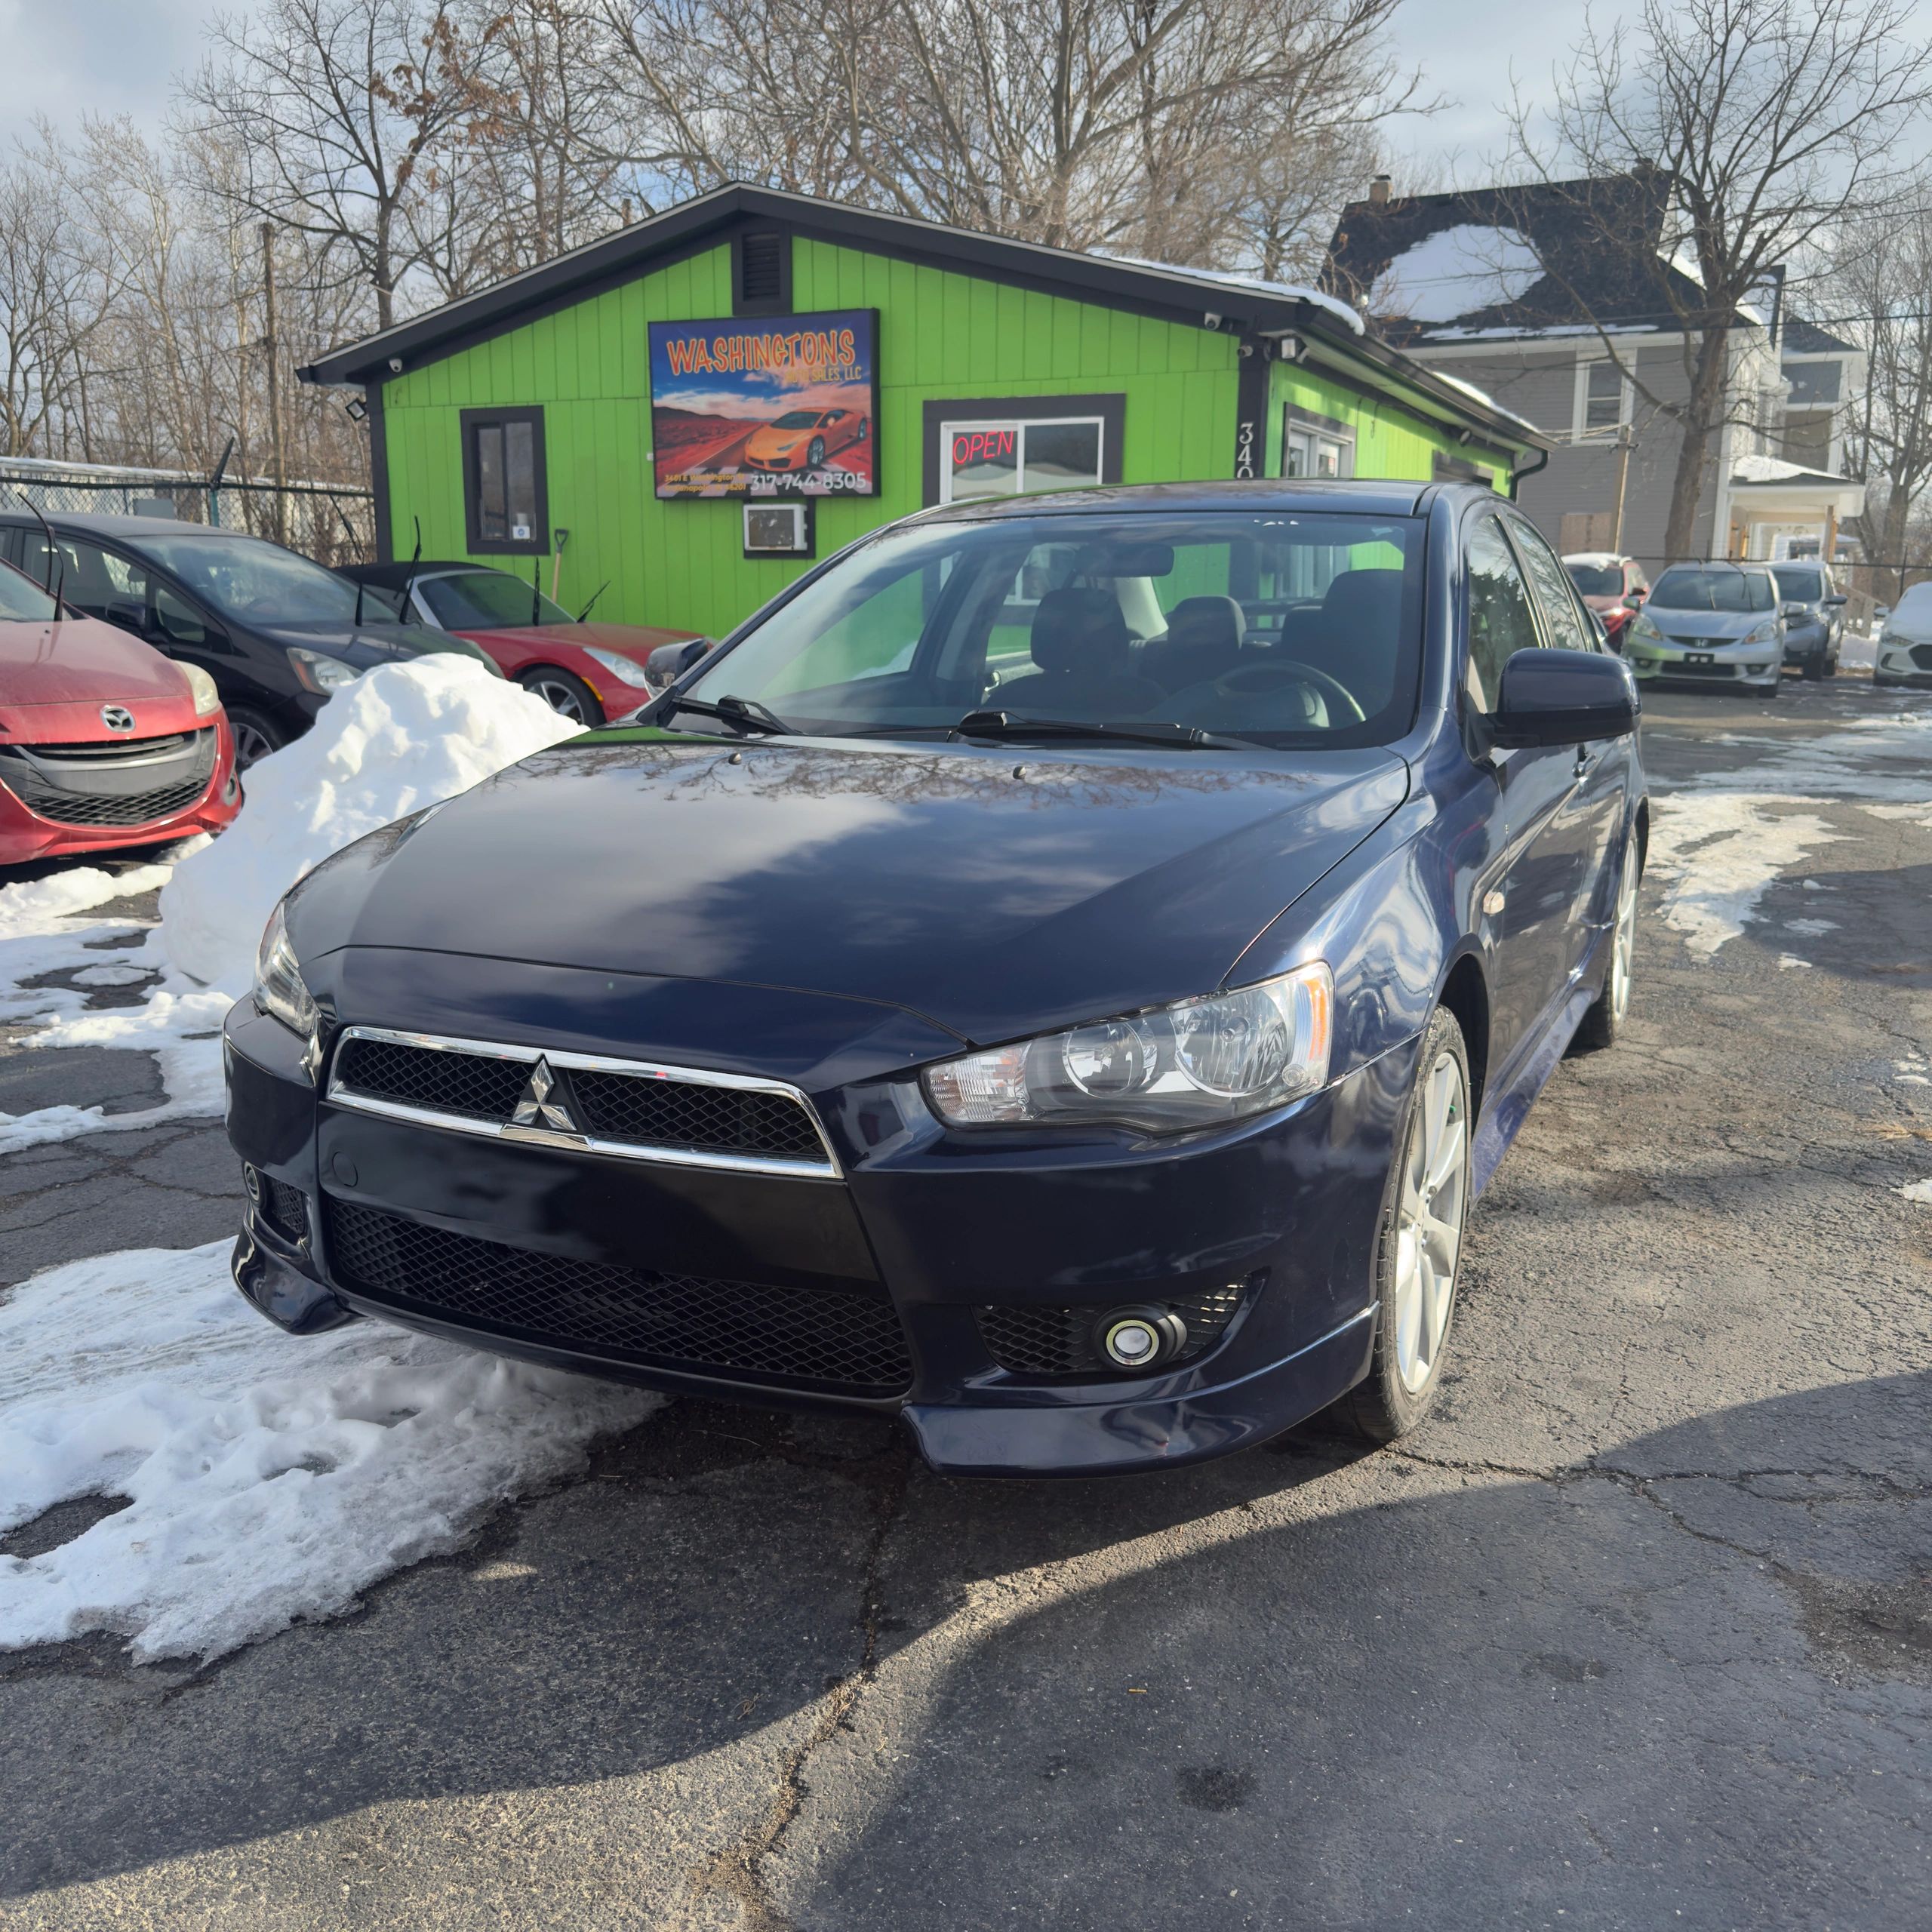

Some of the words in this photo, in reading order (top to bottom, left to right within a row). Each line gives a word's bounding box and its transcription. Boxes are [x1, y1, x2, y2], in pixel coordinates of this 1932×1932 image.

[666, 329, 856, 376] WASHINGTONS
[844, 365, 863, 380] LLC
[953, 429, 1014, 465] OPEN
[690, 472, 734, 483] Whington
[751, 472, 867, 491] 317-744-8305
